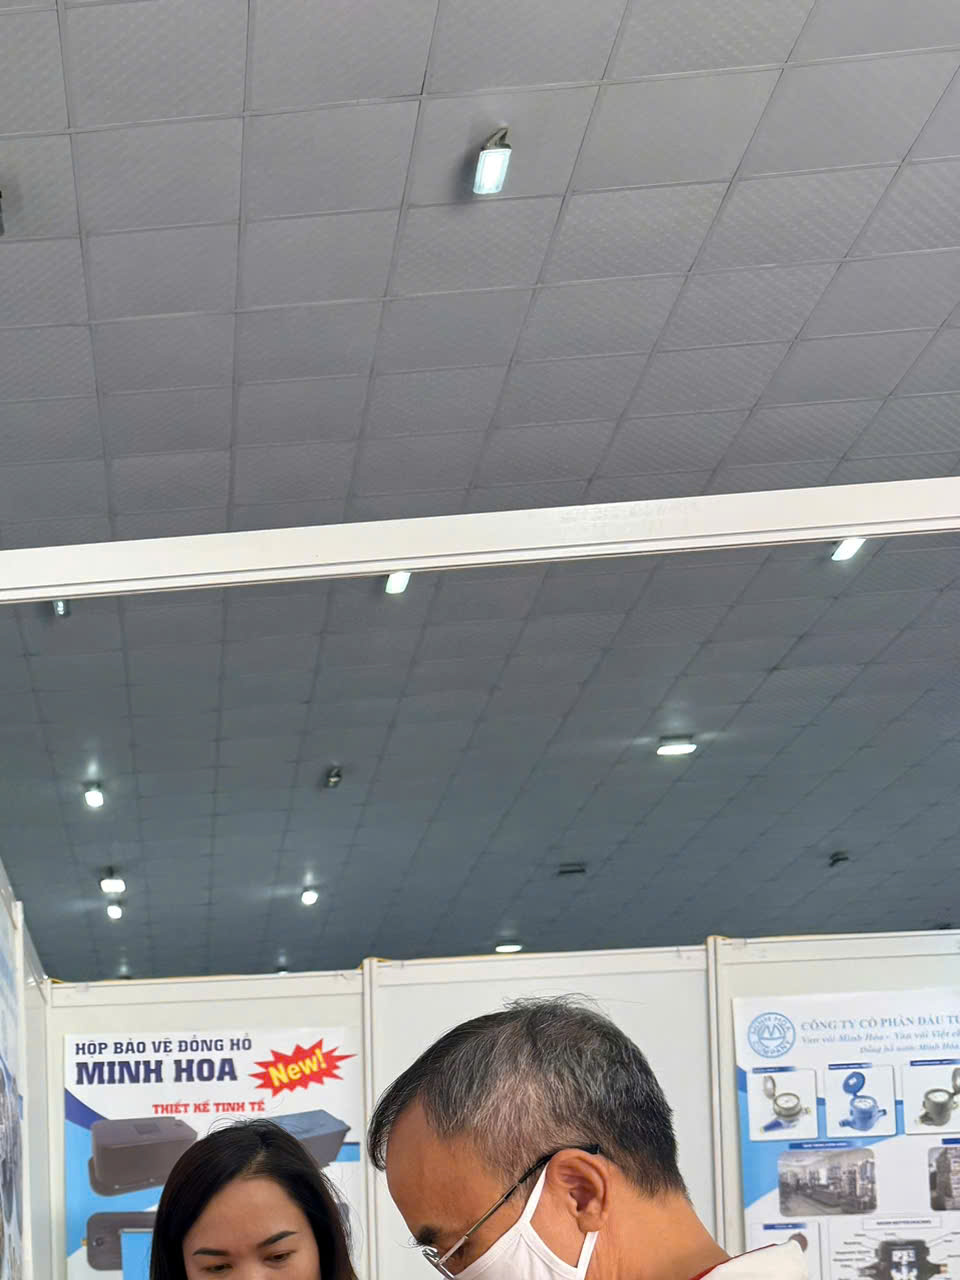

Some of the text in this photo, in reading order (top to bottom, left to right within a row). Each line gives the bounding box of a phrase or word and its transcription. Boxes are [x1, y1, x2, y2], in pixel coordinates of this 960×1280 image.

[841, 1019, 857, 1030] TY
[75, 1033, 252, 1058] HỘP BẢO VỆ ĐỒNG HỒ
[75, 1058, 238, 1085] MINH HOA
[267, 1047, 327, 1087] New!
[152, 1098, 266, 1114] THIẾT KẾ TINH TẾ
